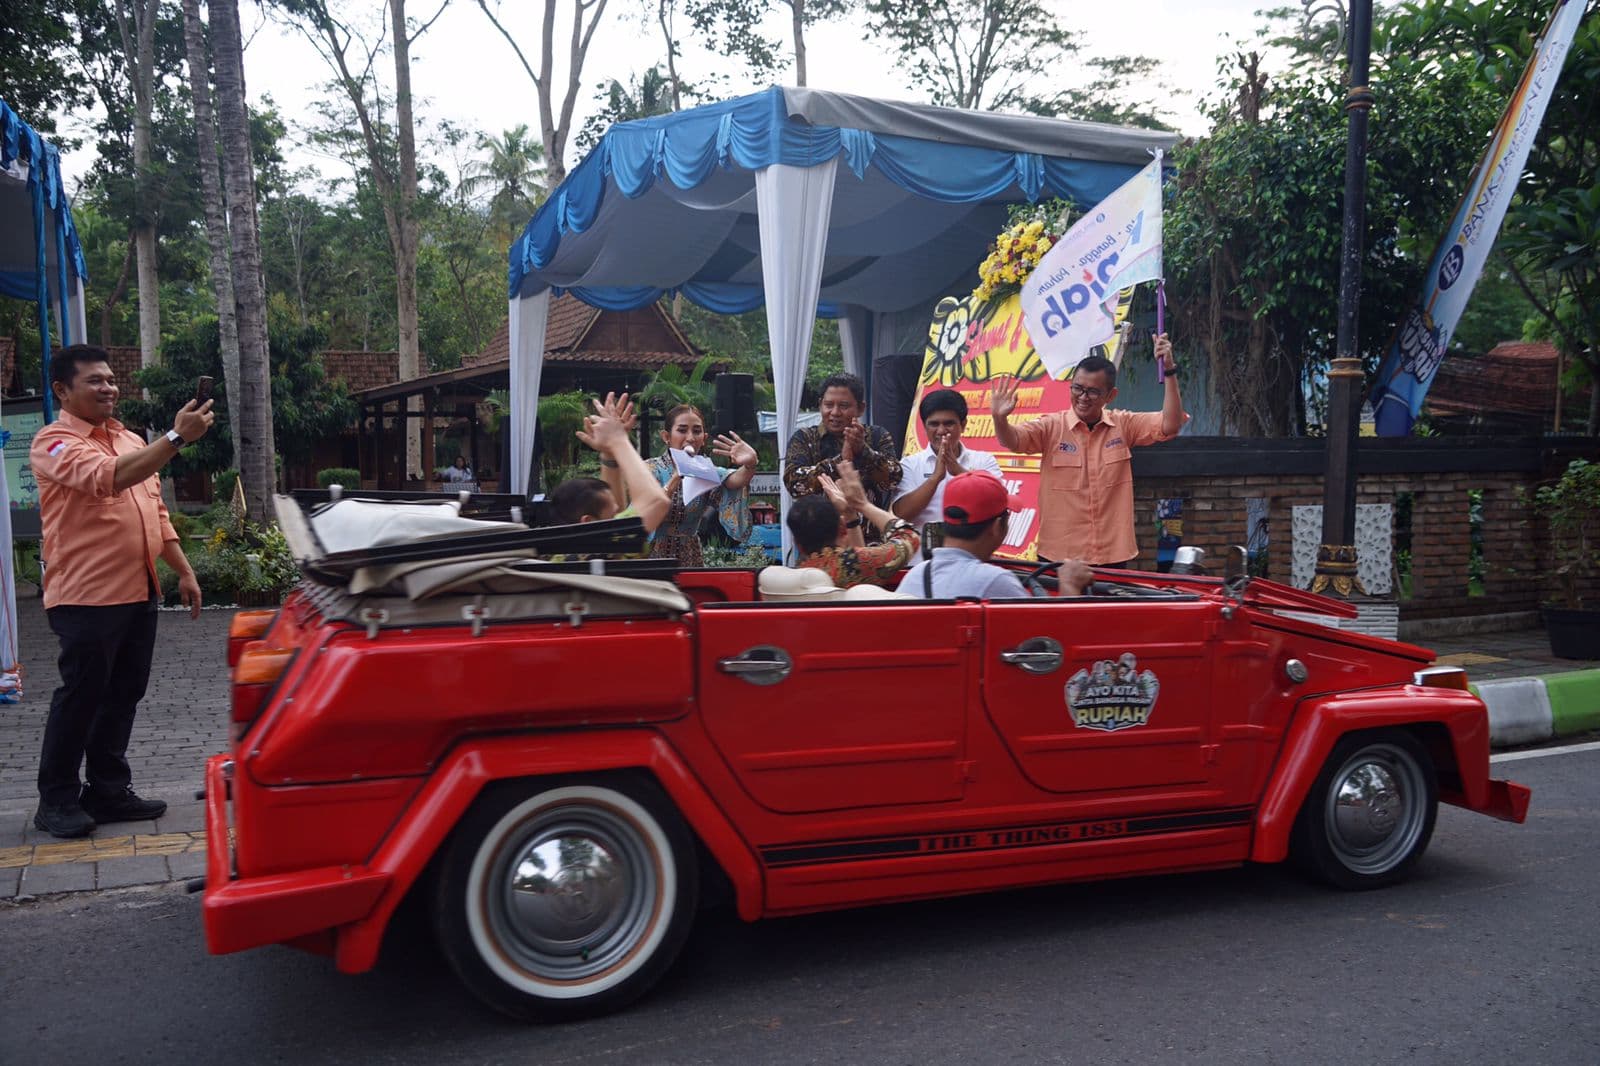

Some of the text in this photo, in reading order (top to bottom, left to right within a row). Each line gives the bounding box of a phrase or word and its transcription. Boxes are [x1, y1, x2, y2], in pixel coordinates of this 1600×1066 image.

[1463, 182, 1499, 239] BANK
[1087, 685, 1139, 697] AYO KITA
[1076, 706, 1148, 724] RUPIAH
[925, 835, 977, 850] THE
[988, 826, 1070, 846] THING
